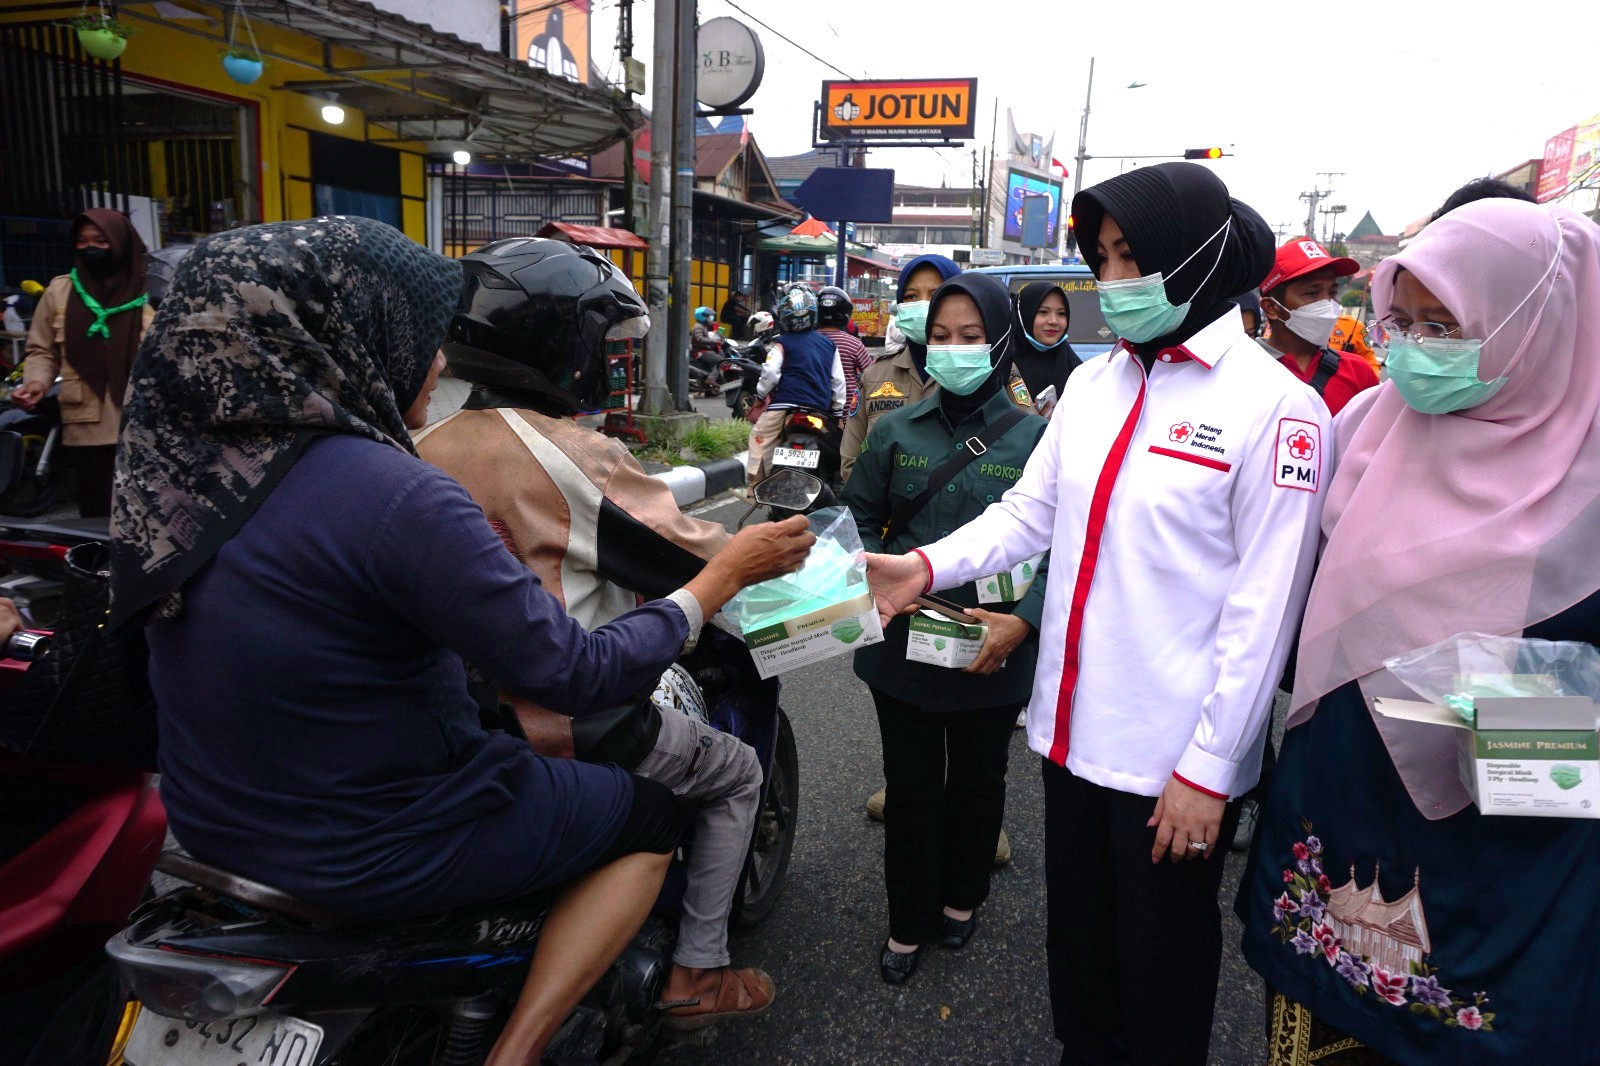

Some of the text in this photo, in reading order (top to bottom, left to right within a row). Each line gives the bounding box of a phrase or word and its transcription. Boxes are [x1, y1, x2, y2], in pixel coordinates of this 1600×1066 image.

[864, 93, 962, 120] JOTUN
[1198, 424, 1222, 435] Palang
[1195, 432, 1216, 442] Merah
[788, 450, 806, 458] 5920
[1190, 440, 1225, 455] Indonesia
[1282, 465, 1316, 484] PMI
[754, 618, 825, 644] JASMINE PREMIUM
[760, 630, 830, 655] Disposable Surgical Mask
[780, 644, 807, 656] Headloop
[1487, 741, 1587, 750] JASMINE PREMIUM
